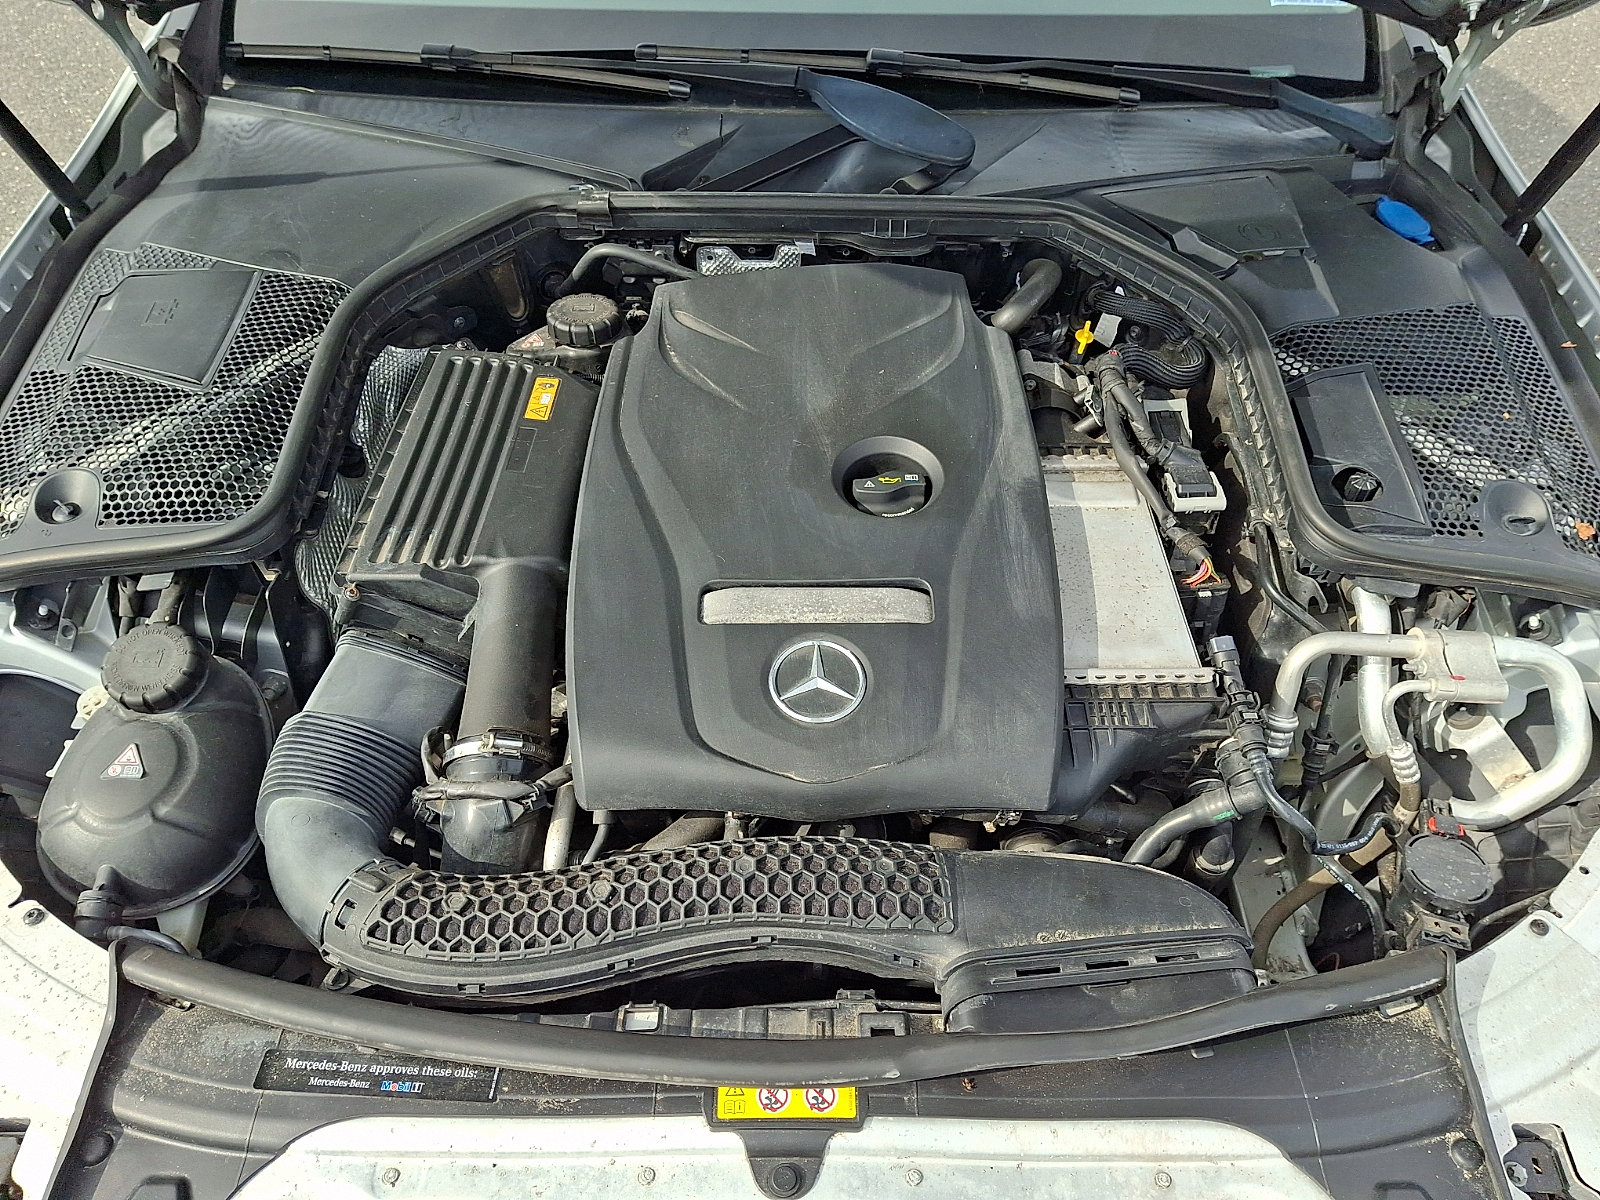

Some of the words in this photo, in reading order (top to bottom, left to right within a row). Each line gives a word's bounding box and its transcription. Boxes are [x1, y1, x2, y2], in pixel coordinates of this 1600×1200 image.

[126, 633, 141, 646] NOT
[284, 1057, 368, 1073] Mercedes-Benz
[370, 1064, 419, 1076] approves
[422, 1065, 453, 1077] these
[454, 1067, 478, 1079] oils:
[308, 1076, 370, 1089] Mercedes-Benz
[381, 1080, 411, 1092] Mobil
